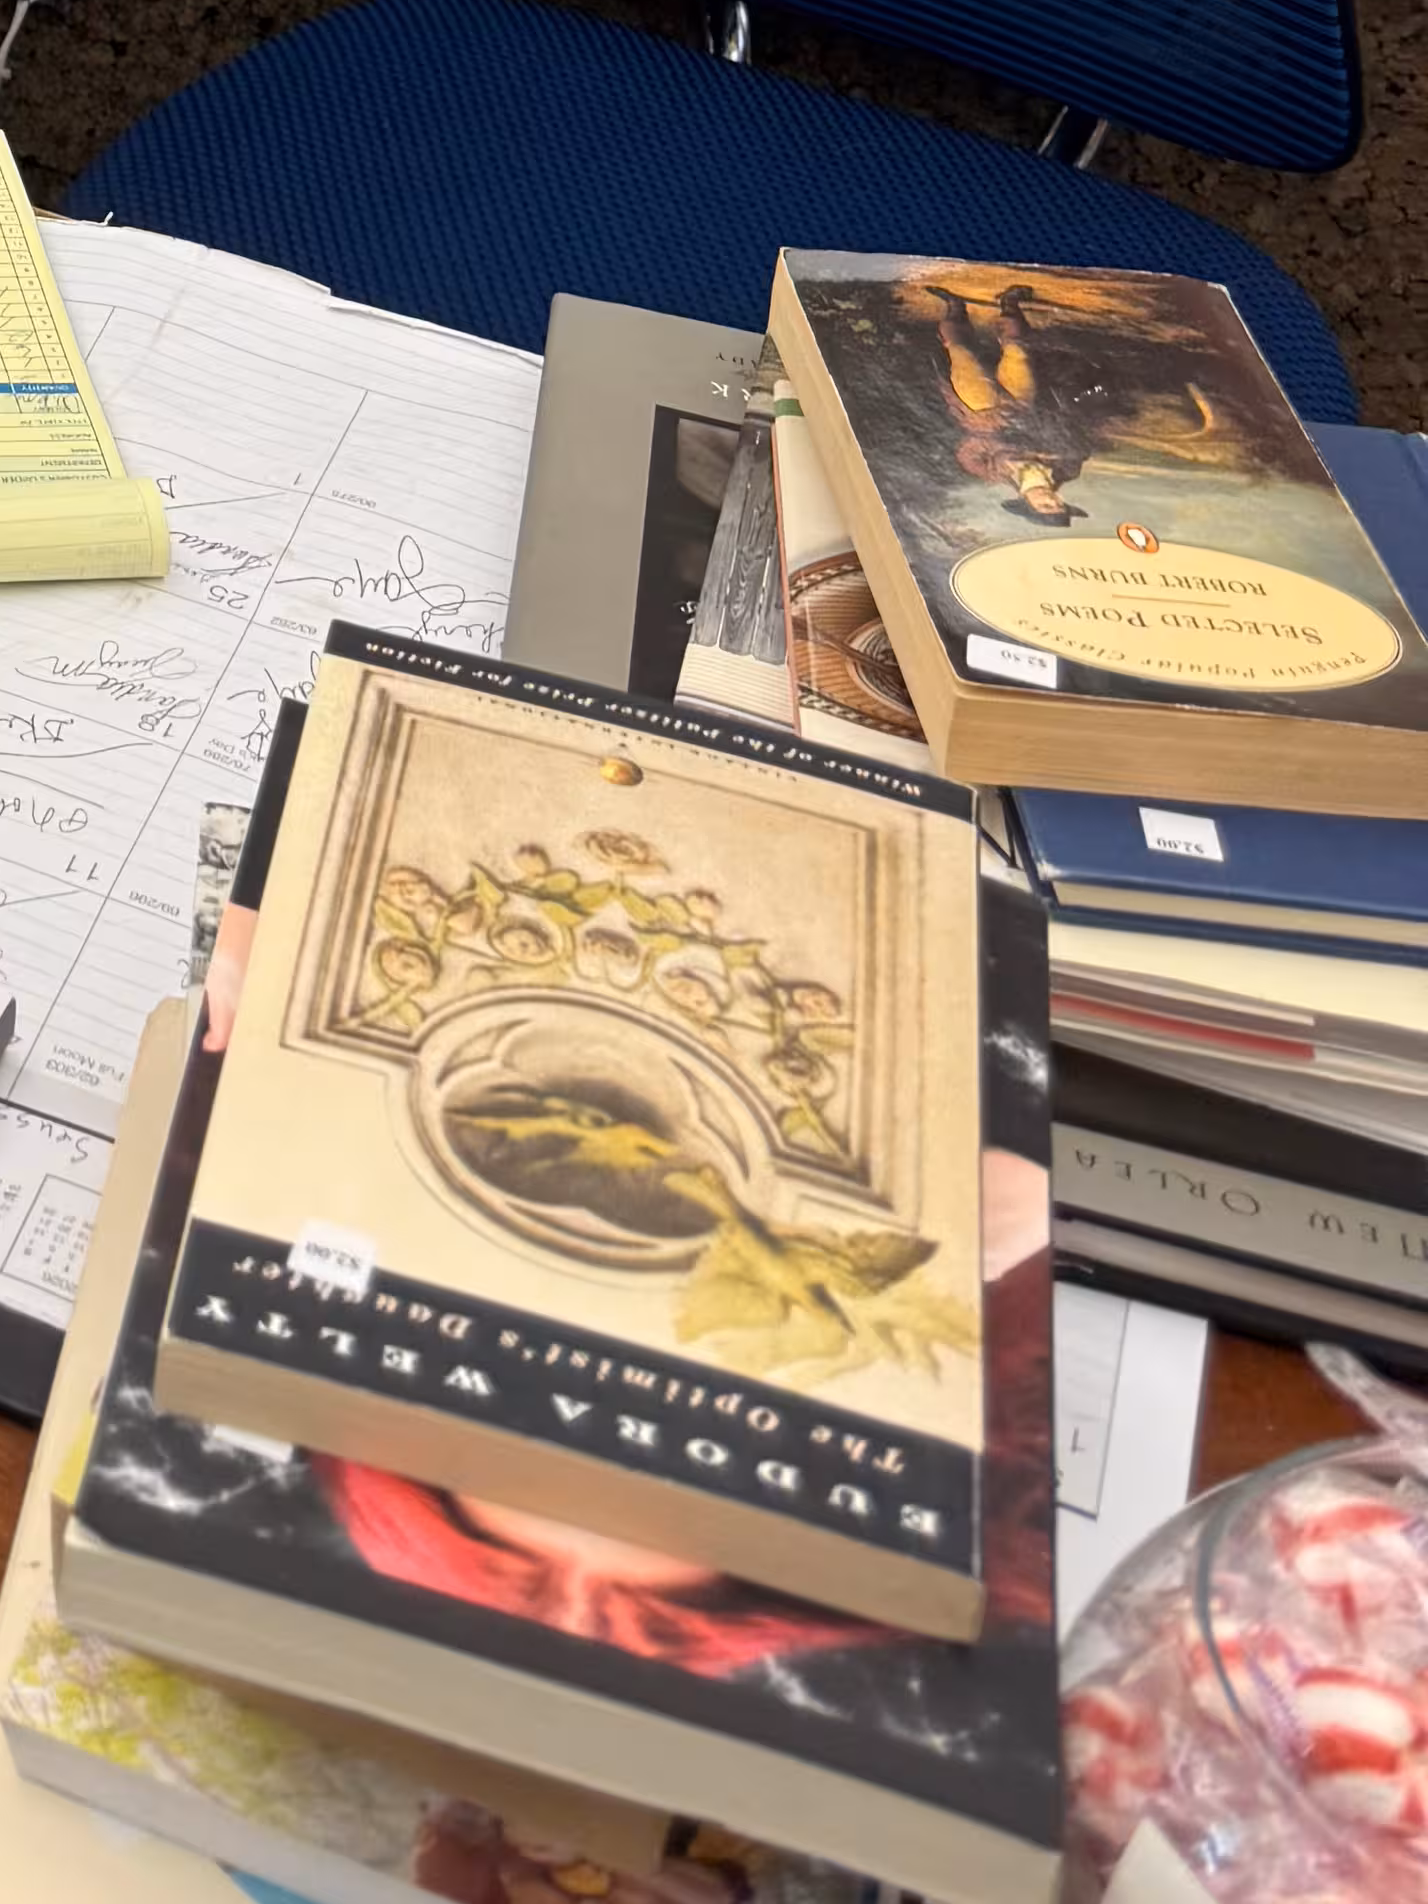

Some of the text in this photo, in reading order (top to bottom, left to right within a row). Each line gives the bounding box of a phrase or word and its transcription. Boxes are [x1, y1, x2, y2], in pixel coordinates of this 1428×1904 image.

[207, 584, 248, 610] 25
[1052, 563, 1268, 598] ROBERT BURNS
[1039, 601, 1323, 646] SELECTED POEMS
[1014, 618, 1368, 680] Penguin Popular Classics
[138, 711, 177, 740] 18
[364, 641, 922, 797] Winner of the Pulitzer Prize for Fiction
[53, 1045, 96, 1071] Moon
[196, 1293, 941, 1538] EUDORA WELTY
[499, 1328, 904, 1476] The Optimist's
